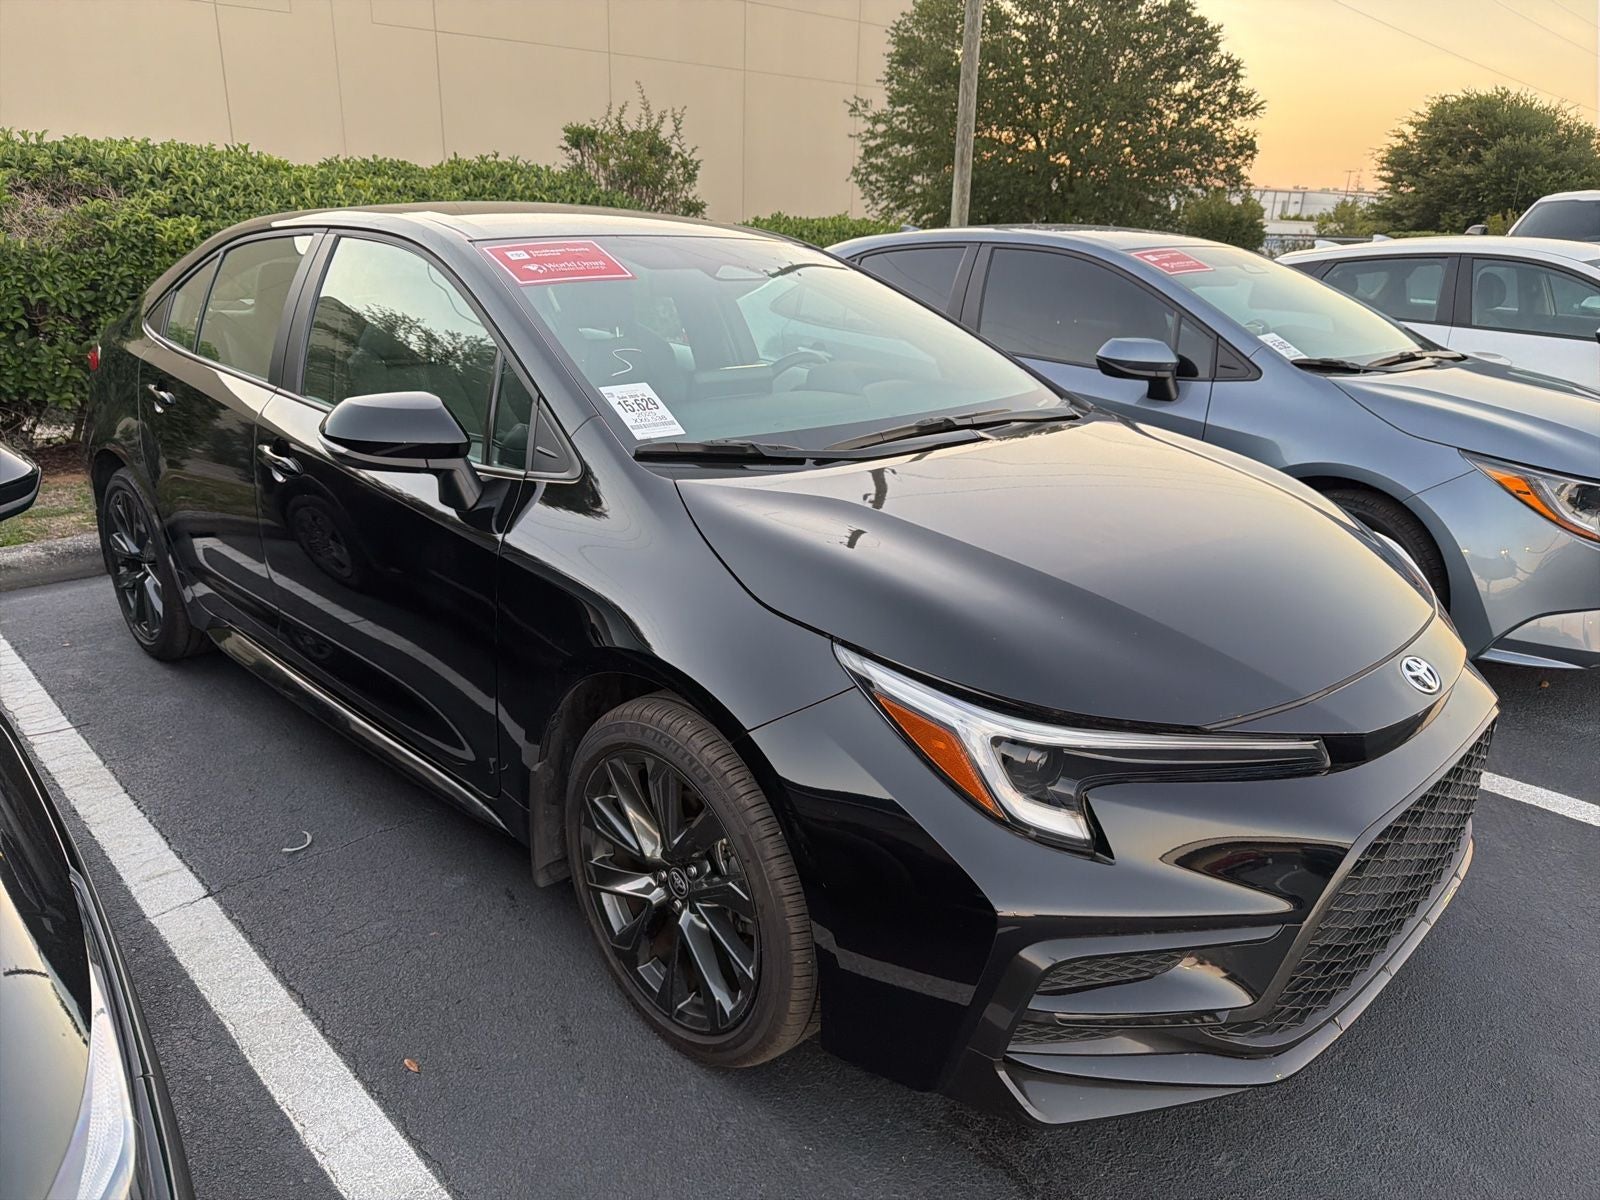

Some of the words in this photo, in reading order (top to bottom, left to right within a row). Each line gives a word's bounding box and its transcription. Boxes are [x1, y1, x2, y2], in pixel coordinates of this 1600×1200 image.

[543, 260, 575, 269] World
[617, 398, 659, 413] 15:629
[644, 728, 711, 785] MICHELIN
